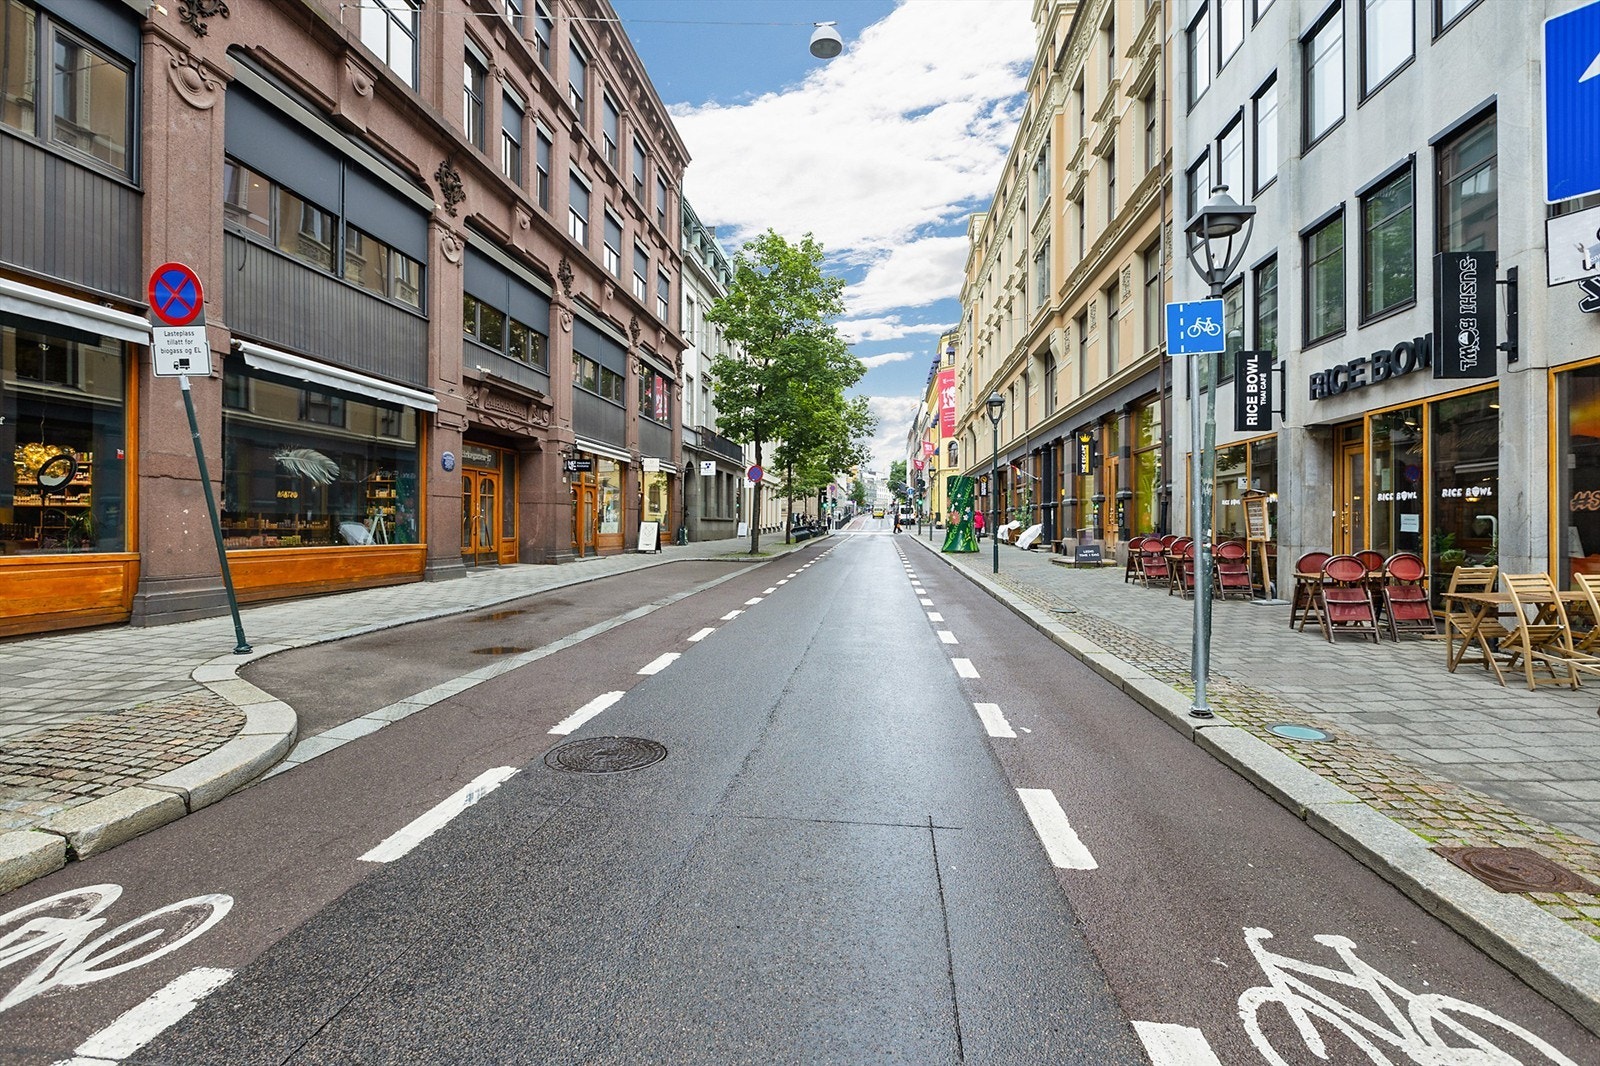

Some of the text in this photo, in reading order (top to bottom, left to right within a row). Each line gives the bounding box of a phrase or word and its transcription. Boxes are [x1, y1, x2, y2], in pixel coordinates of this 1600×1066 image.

[1458, 257, 1480, 371] SUSHI BOWL
[161, 347, 183, 355] biogass
[1309, 332, 1432, 401] RICE BOW
[1246, 354, 1258, 426] RICE BOWL
[1377, 490, 1418, 502] RICE BOWL
[1440, 486, 1493, 498] RICE BOWL
